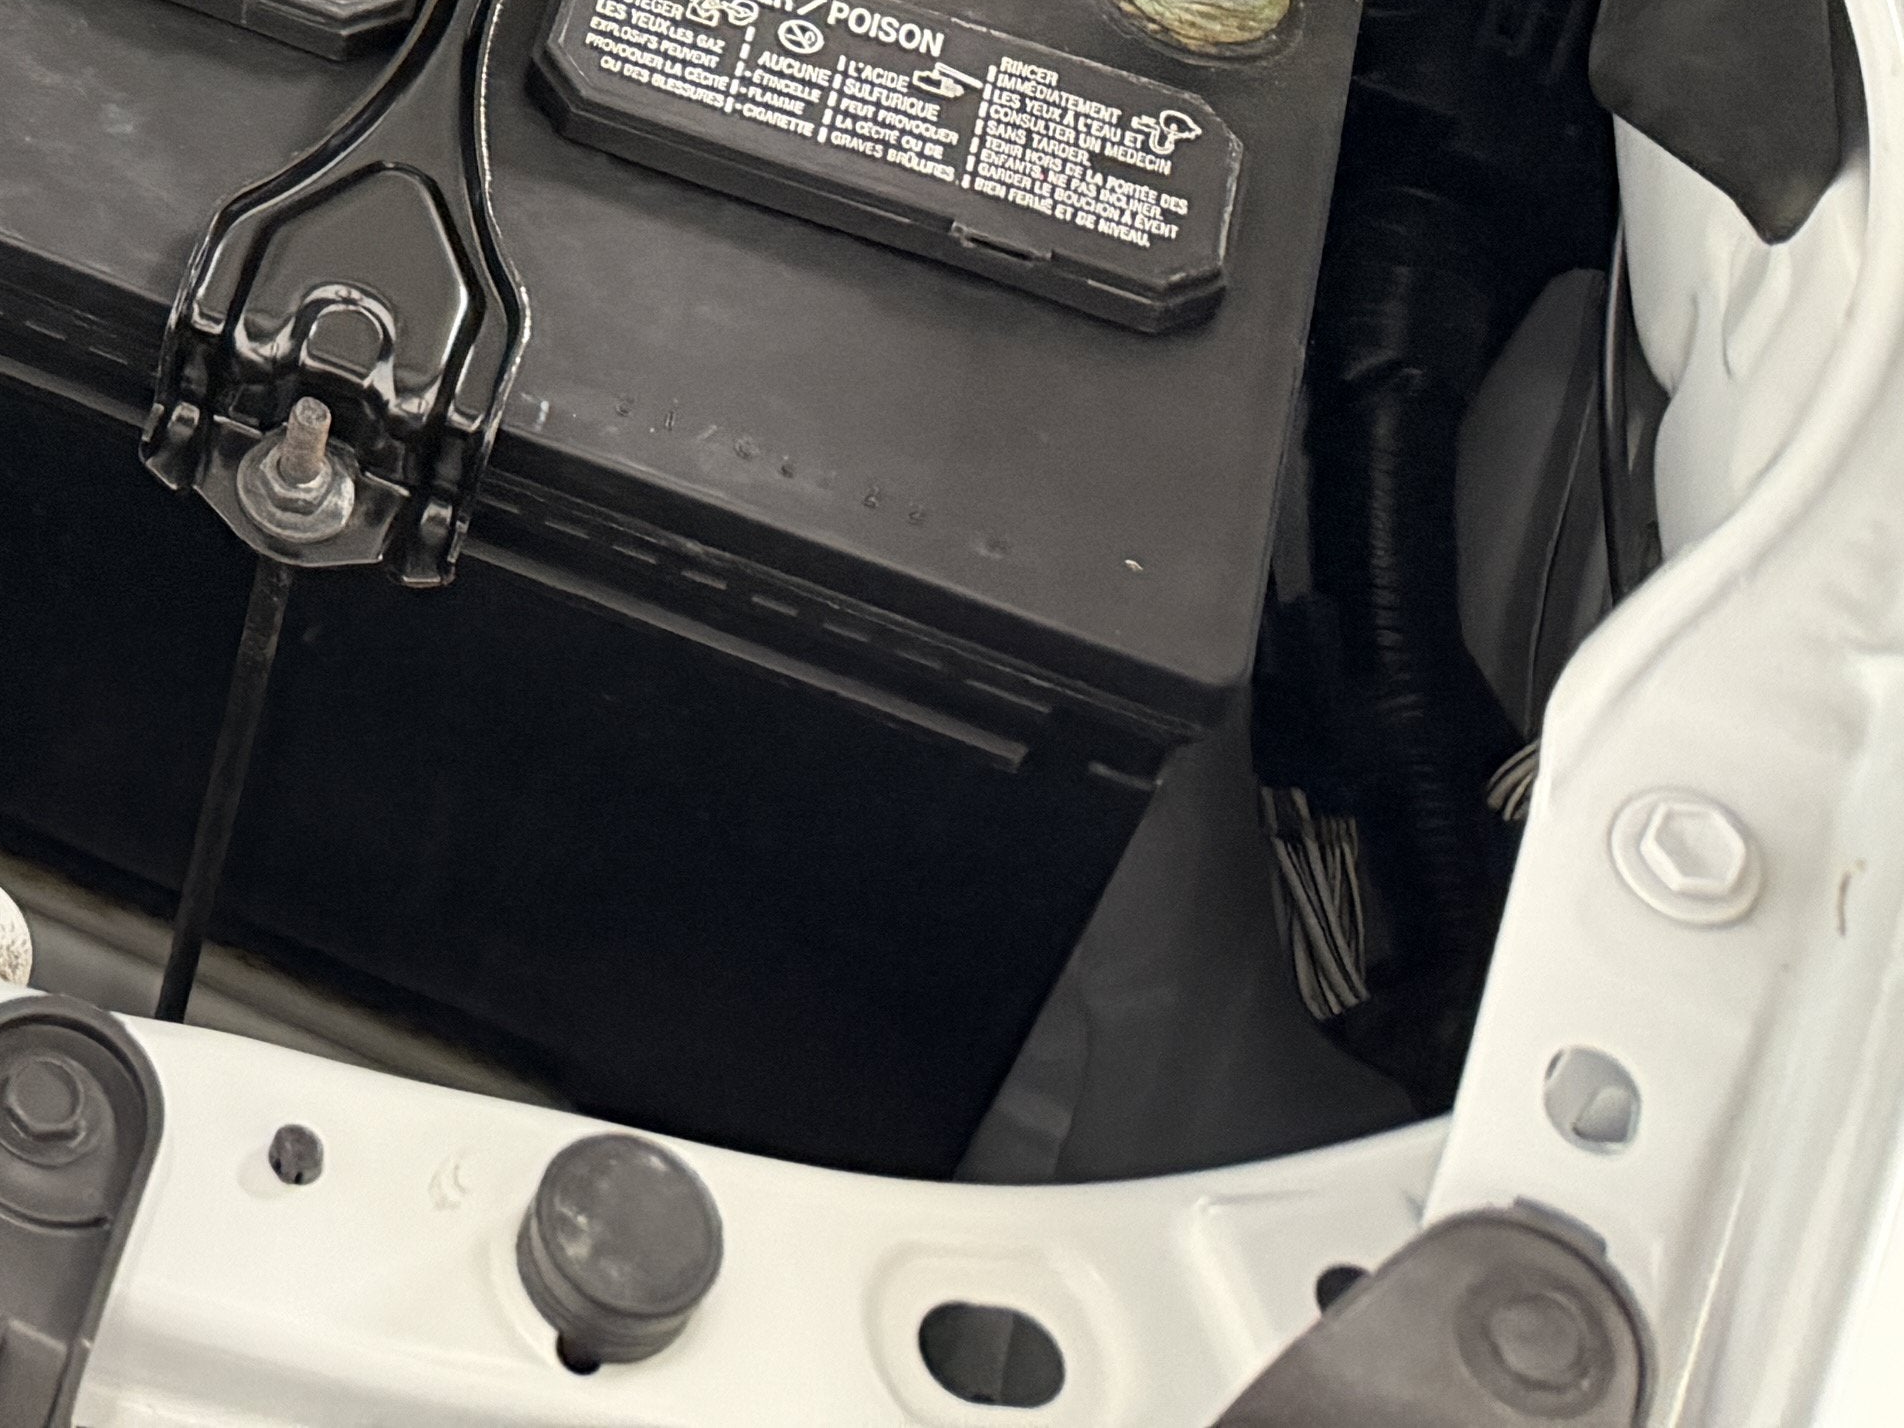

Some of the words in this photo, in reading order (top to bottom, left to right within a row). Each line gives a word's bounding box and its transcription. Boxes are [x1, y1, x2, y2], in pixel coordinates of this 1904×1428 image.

[631, 8, 671, 35] YEUX
[826, 0, 945, 58] POISON
[757, 50, 833, 87] AUCUNE
[843, 77, 941, 122] SULFURIQUE
[992, 88, 1021, 110] LES
[1025, 97, 1063, 122] YEUX
[1123, 130, 1145, 149] ET
[985, 119, 1027, 145] SANS
[989, 104, 1076, 144] CONSULTER
[1078, 132, 1102, 154] UN
